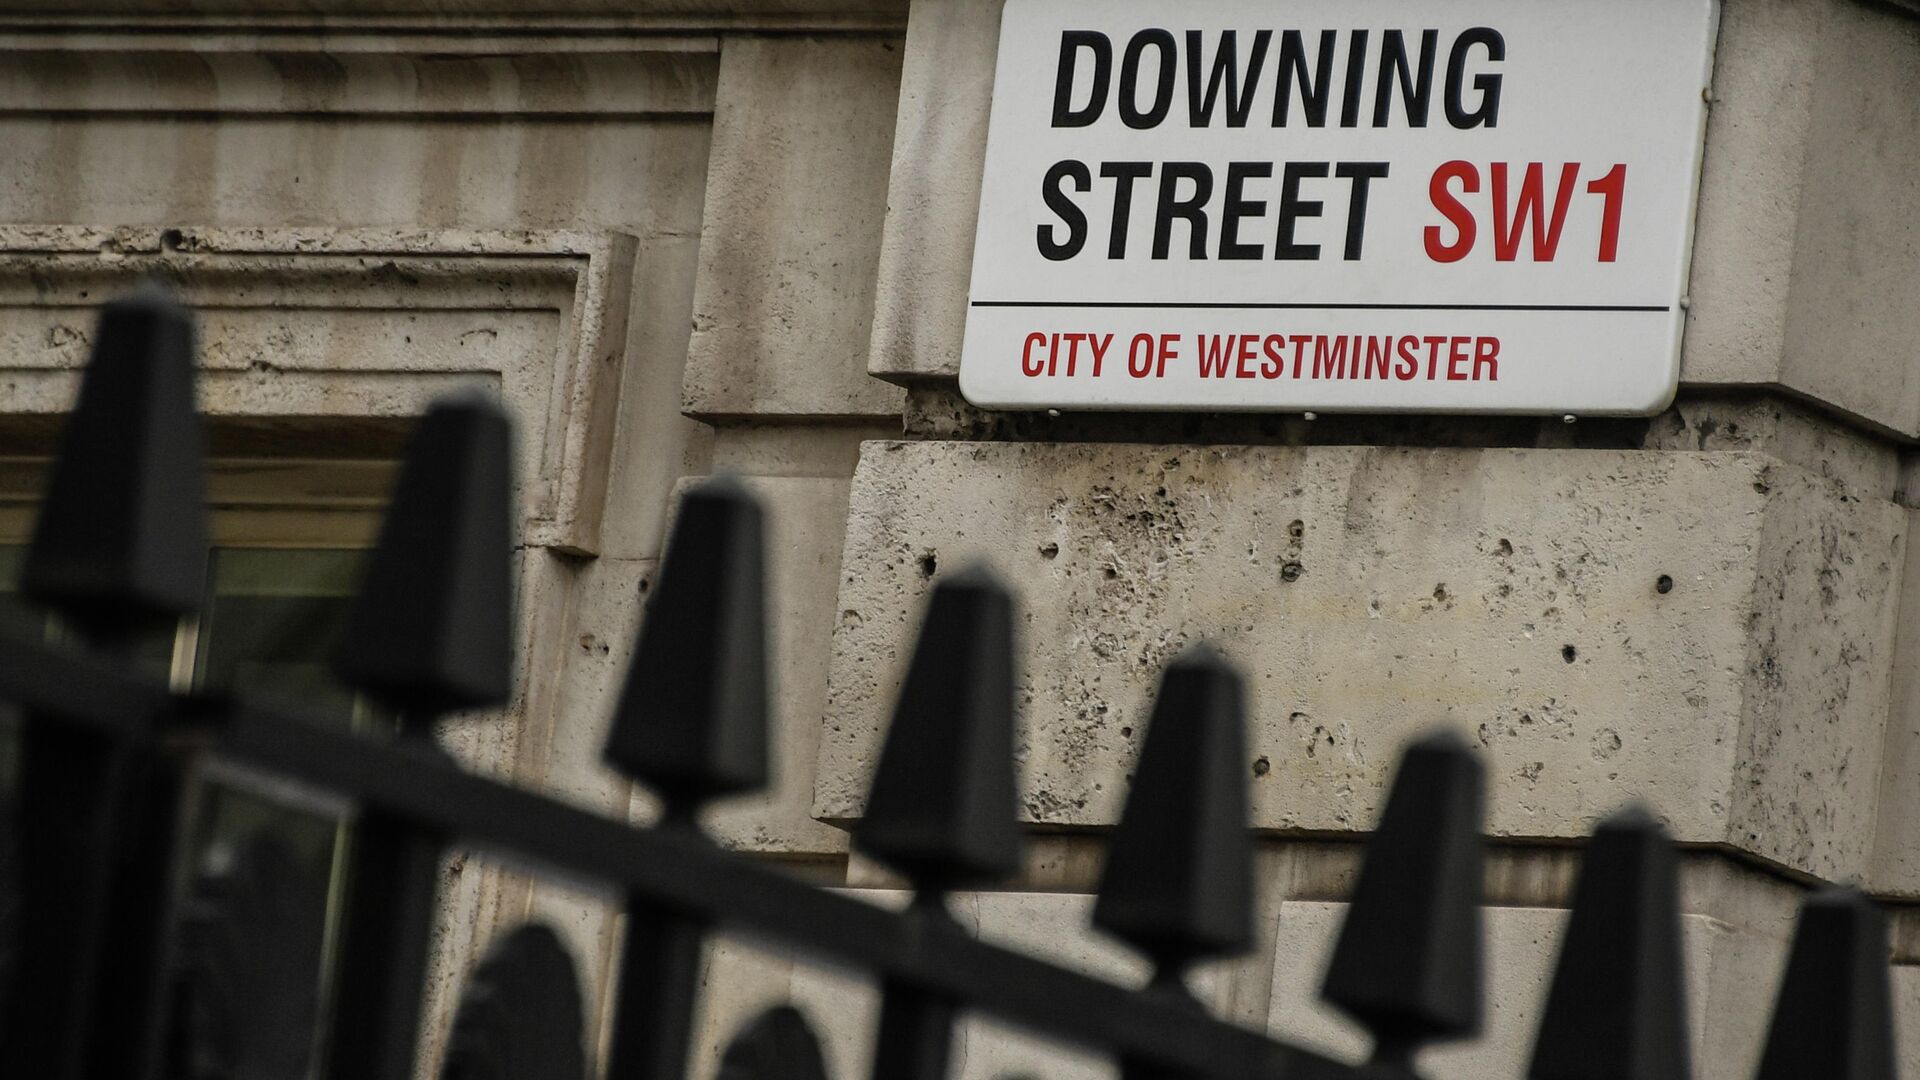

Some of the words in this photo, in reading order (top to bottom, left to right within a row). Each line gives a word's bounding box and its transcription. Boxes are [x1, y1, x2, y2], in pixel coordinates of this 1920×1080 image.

[1050, 26, 1506, 131] DOWNING
[1035, 159, 1391, 262] STREET
[1423, 159, 1627, 264] SW1
[1021, 331, 1115, 378] CITY
[1127, 332, 1181, 379] OF
[1197, 333, 1501, 382] WESTMINSTER
